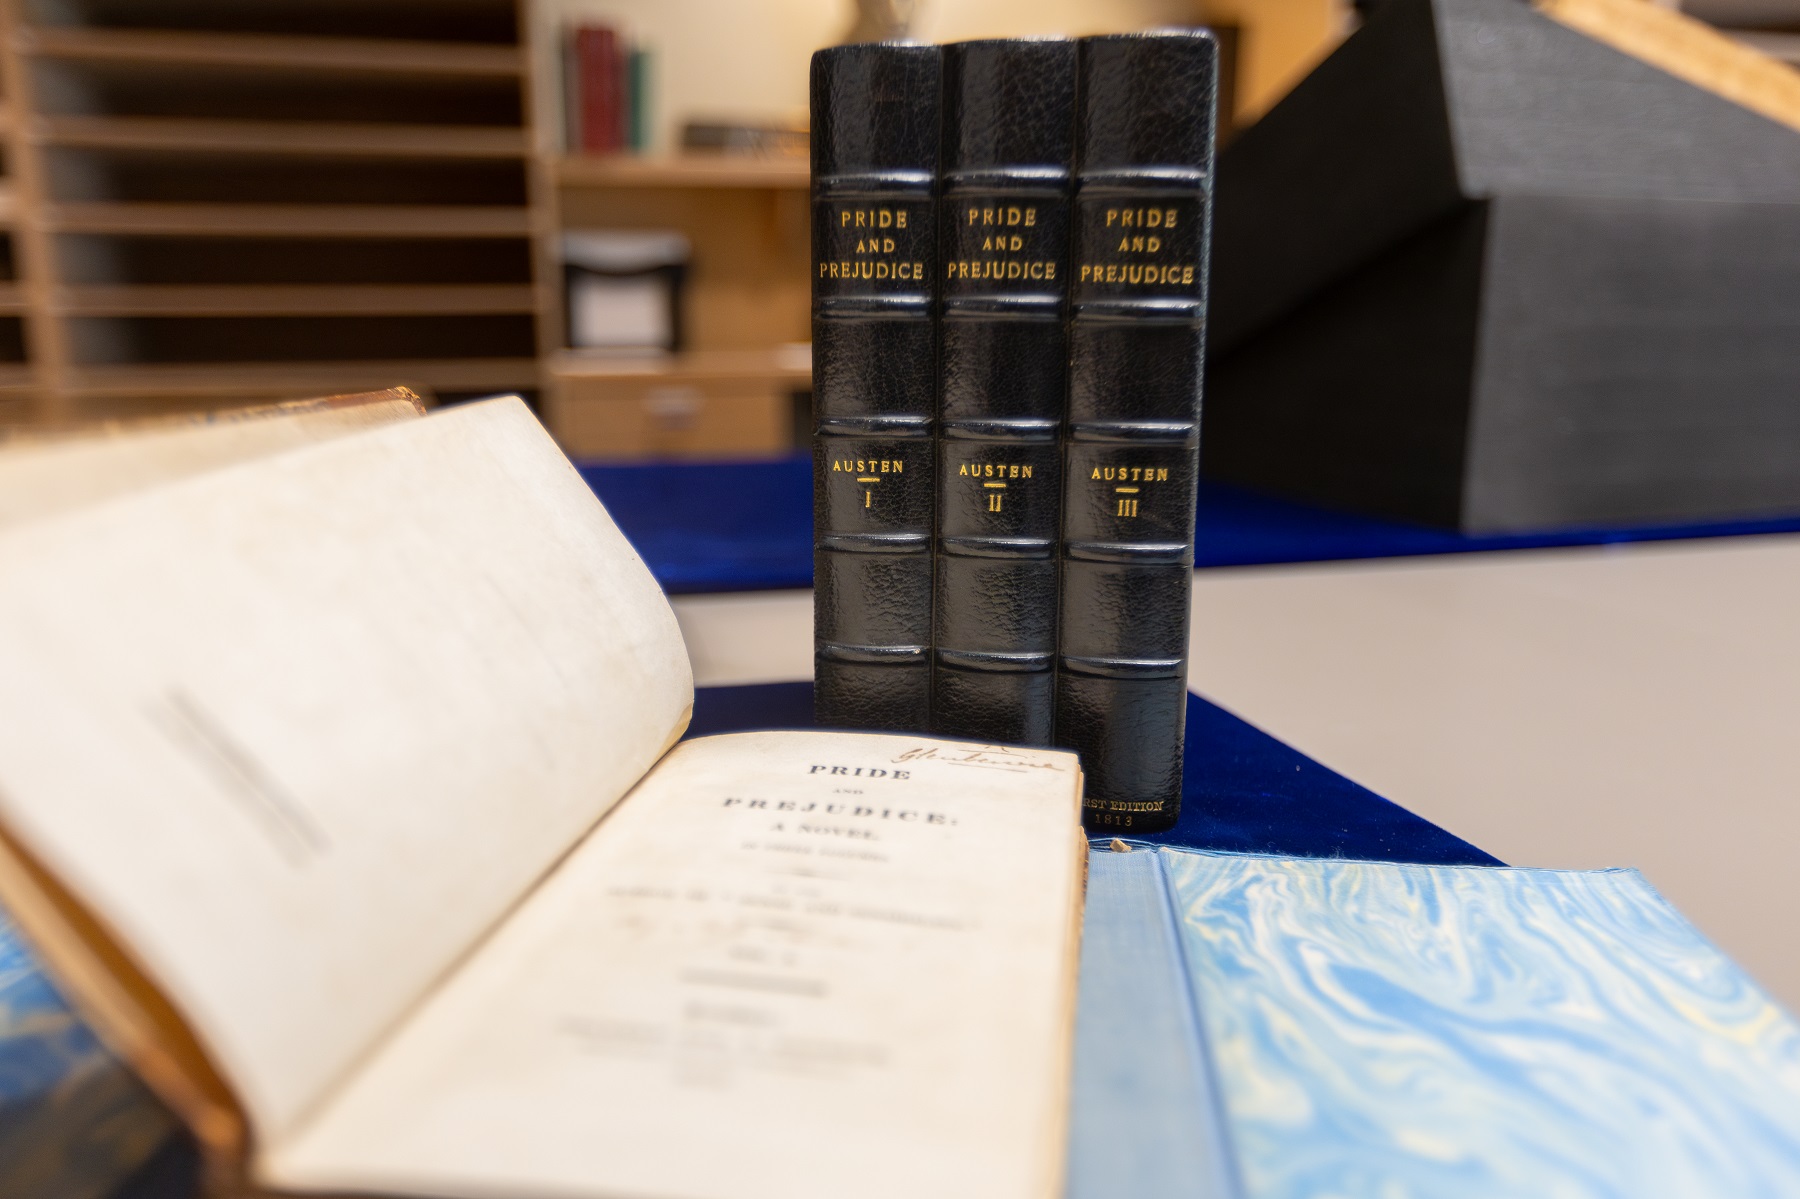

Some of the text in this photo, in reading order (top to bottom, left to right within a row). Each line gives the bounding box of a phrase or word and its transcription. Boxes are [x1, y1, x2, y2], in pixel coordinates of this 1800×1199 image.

[841, 209, 907, 229] PRIDE
[968, 207, 1036, 227] PRIDE
[1106, 208, 1177, 228] PRIDE
[856, 237, 896, 253] AND
[982, 235, 1023, 251] AND
[1118, 236, 1161, 253] AND
[819, 261, 923, 280] PREJUDICE
[947, 260, 1056, 280] PREJUDICE
[1080, 264, 1194, 285] PREJUDICE
[832, 459, 904, 473] AUSTEN
[959, 463, 1034, 479] AUSTEN
[1091, 467, 1169, 481] AUSTEN
[865, 490, 872, 509] I
[989, 493, 1002, 513] II
[1117, 499, 1138, 518] III
[808, 764, 911, 780] PRIDE
[1083, 798, 1164, 812] RST EDITION
[1095, 814, 1133, 827] 1813
